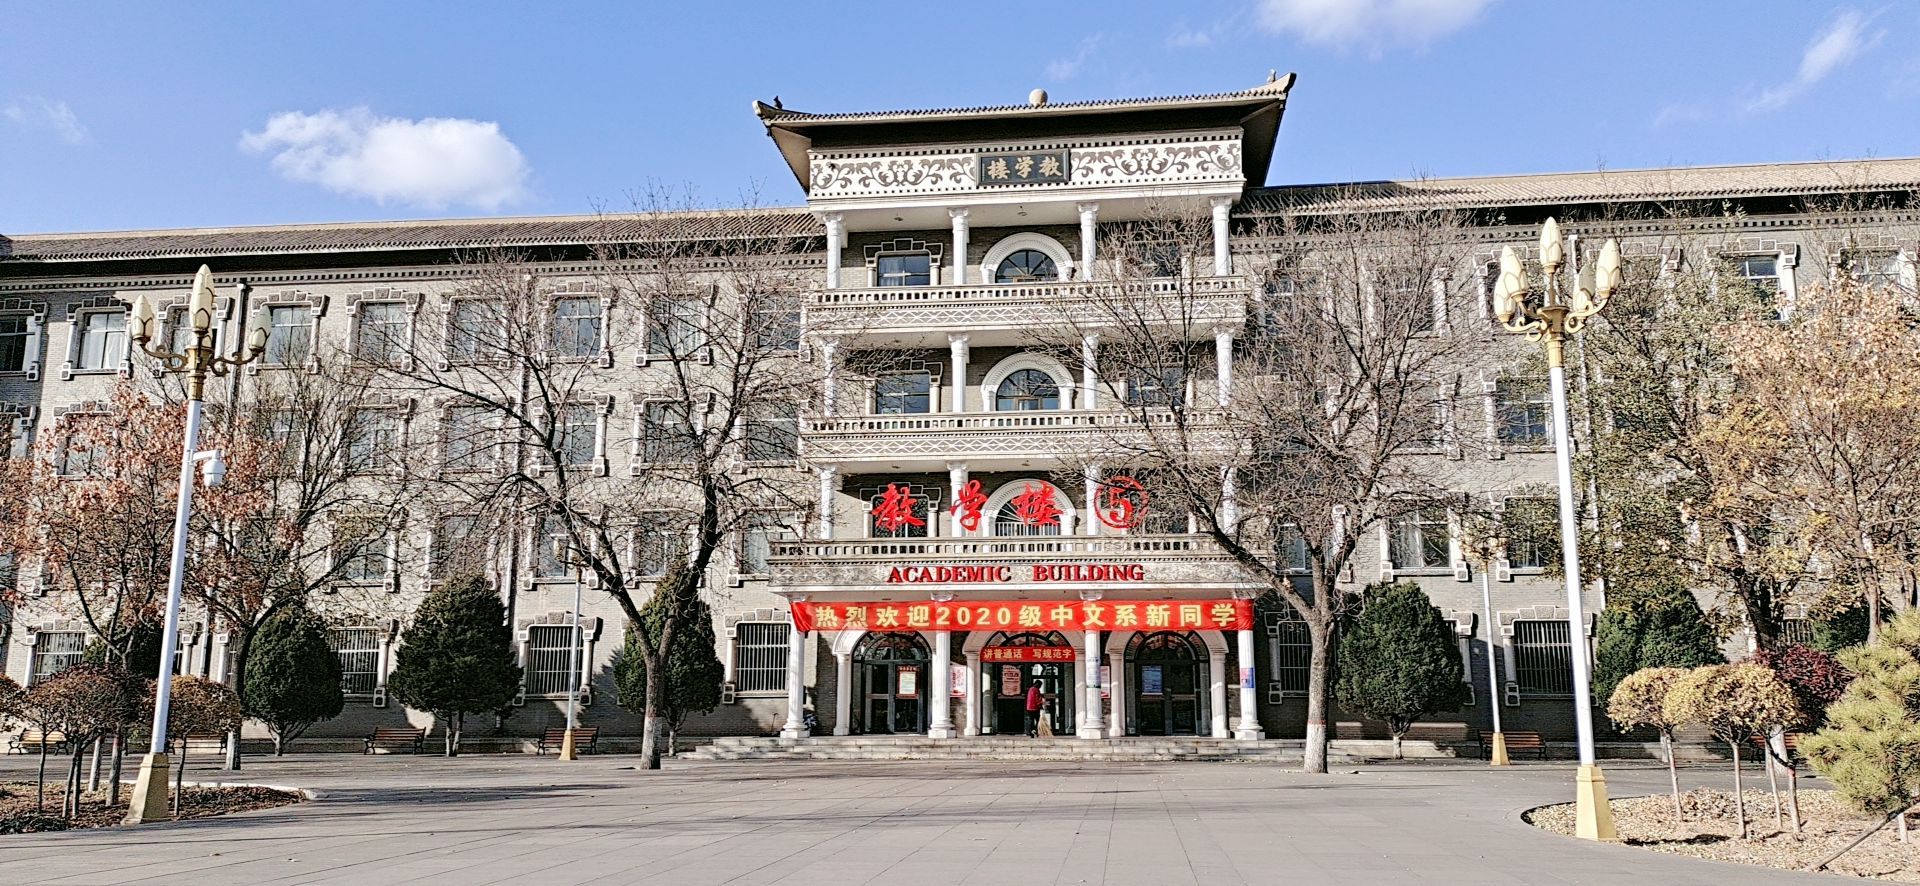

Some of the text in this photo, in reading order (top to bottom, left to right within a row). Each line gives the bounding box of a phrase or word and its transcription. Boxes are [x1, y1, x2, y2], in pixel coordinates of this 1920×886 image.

[887, 564, 1145, 583] ACADEMIC BUILDING
[815, 603, 1236, 628] 热烈欢迎2020级中文系新同学
[983, 648, 1072, 659] 讲普通话 写规范字
